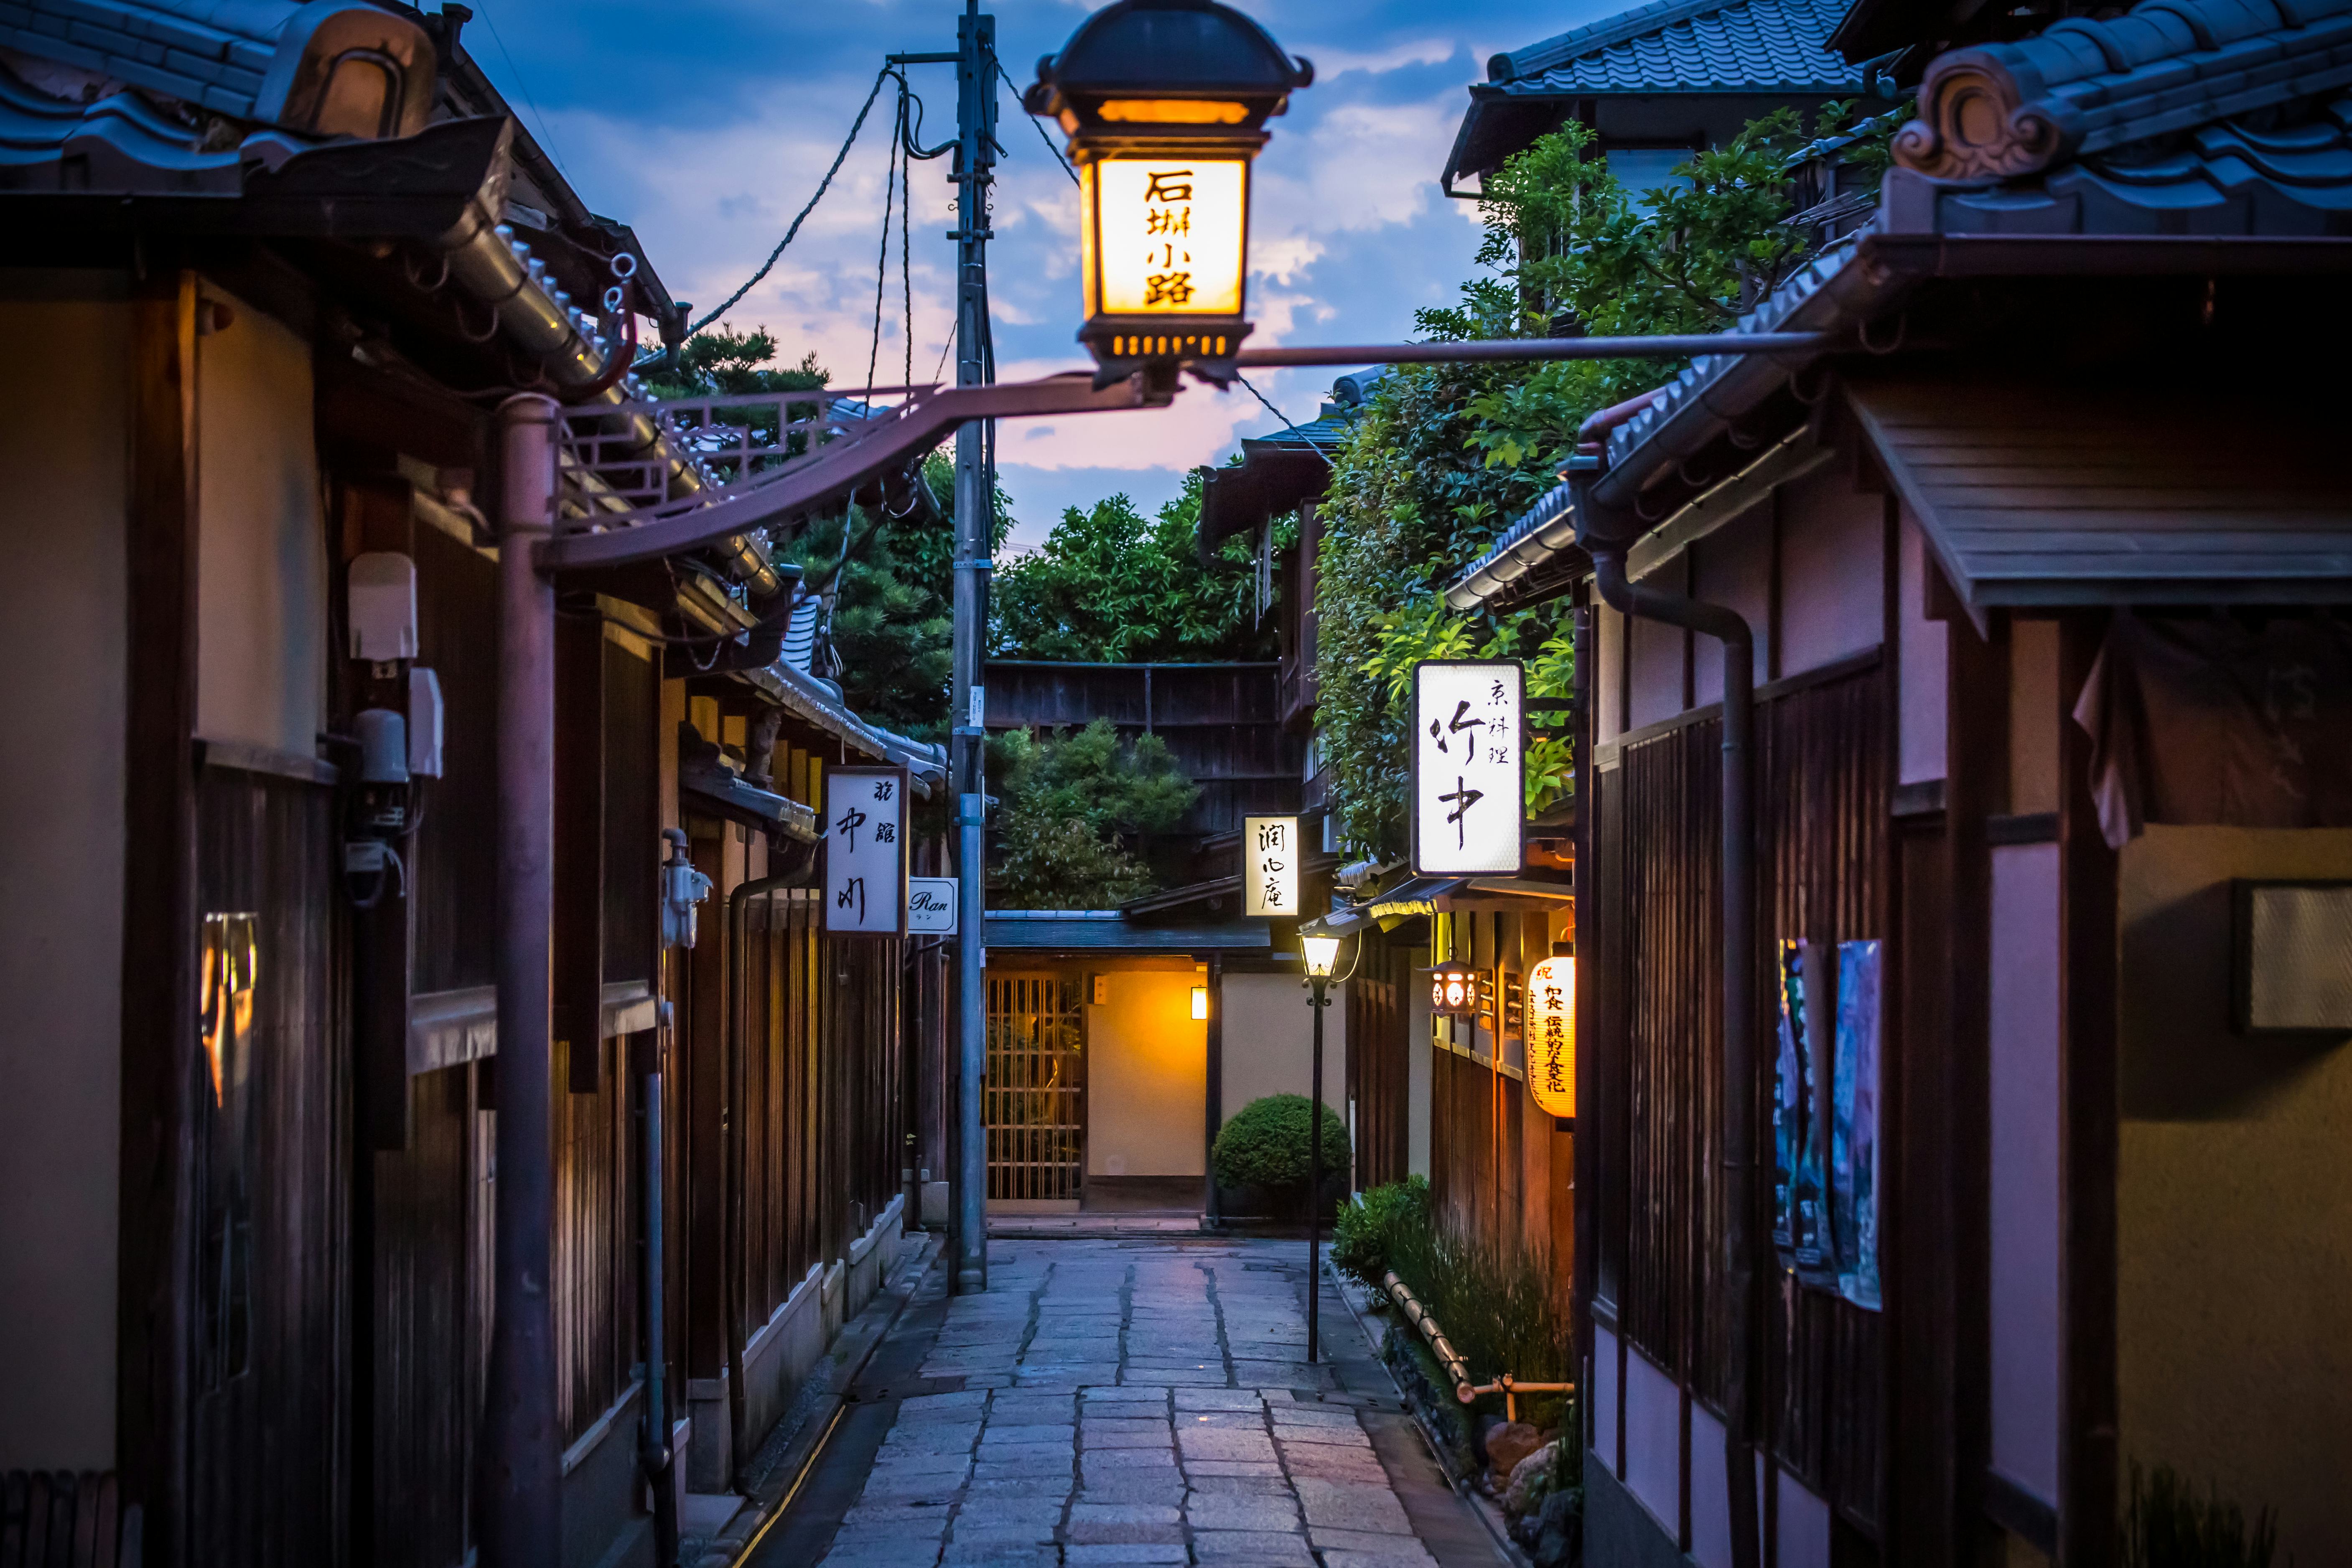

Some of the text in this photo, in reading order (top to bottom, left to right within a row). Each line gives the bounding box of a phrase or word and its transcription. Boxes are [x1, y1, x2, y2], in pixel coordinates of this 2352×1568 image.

[1488, 680, 1509, 764] 京料理
[874, 781, 896, 843] 旅館
[1430, 700, 1486, 851] 竹中
[909, 891, 947, 911] Ran
